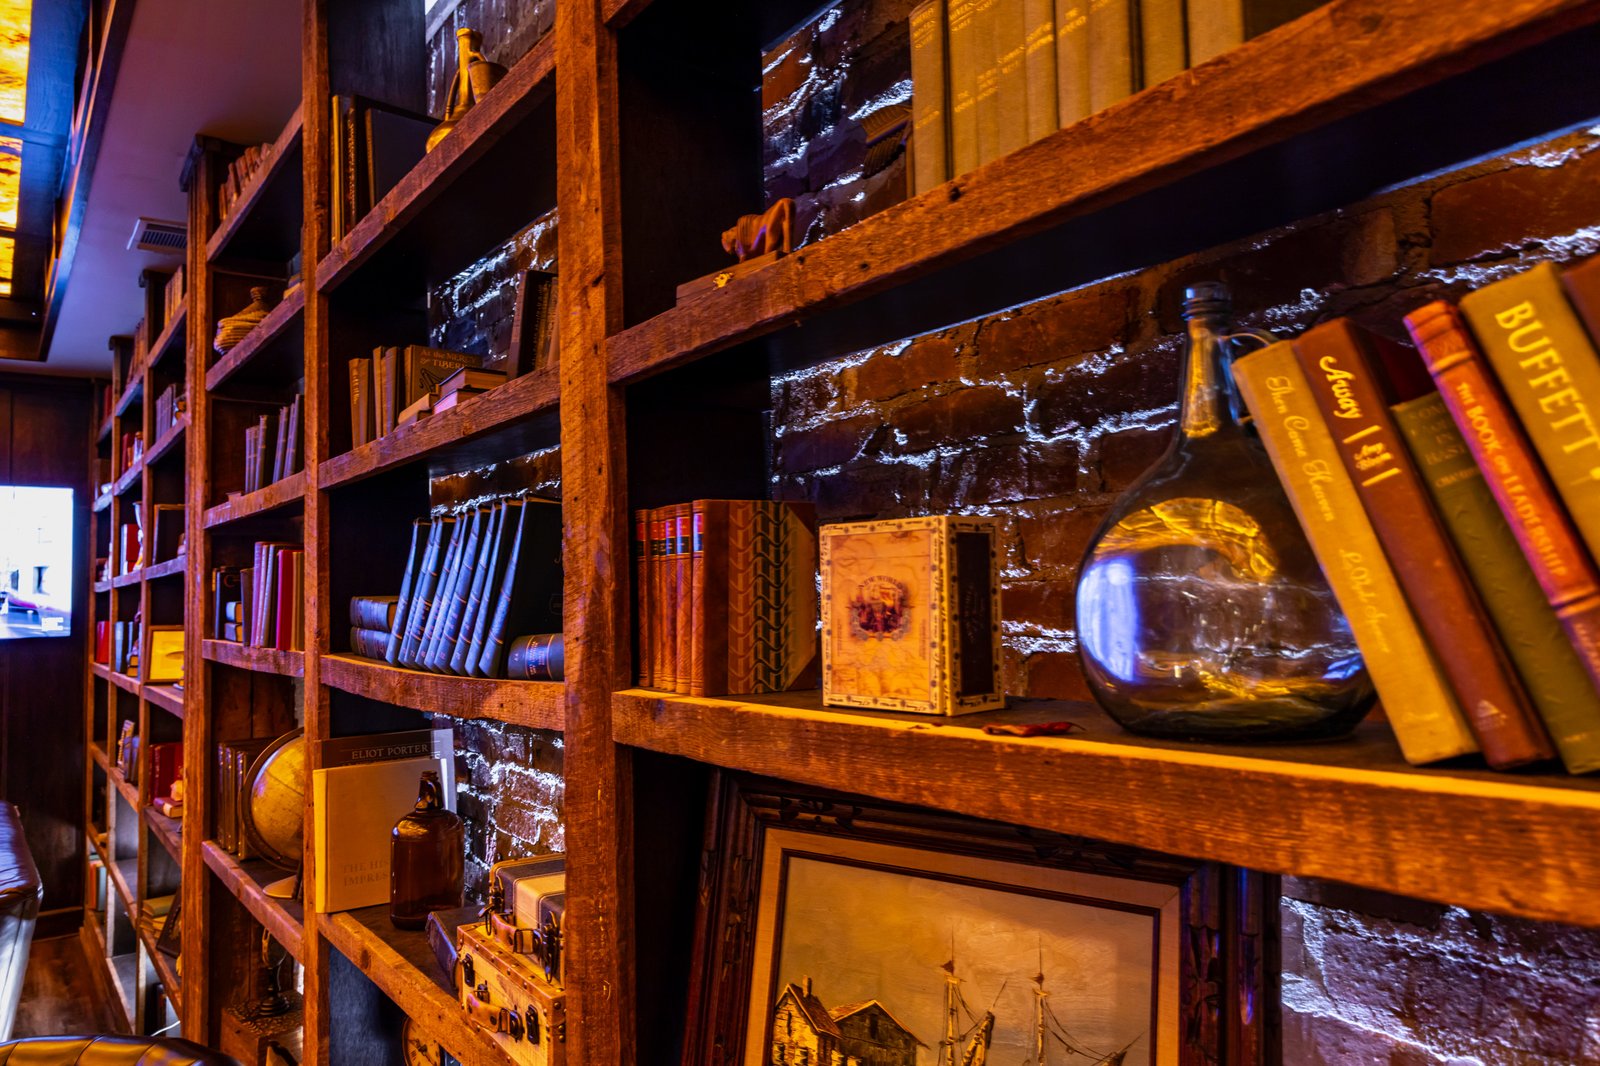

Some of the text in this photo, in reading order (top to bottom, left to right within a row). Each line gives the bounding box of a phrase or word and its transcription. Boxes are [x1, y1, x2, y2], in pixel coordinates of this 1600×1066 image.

[1265, 375, 1336, 522] Then Came Heaven
[1320, 354, 1363, 419] Away
[1496, 300, 1600, 455] BUFFETT
[1456, 382, 1474, 406] THE
[1466, 398, 1500, 454] BOOK
[1502, 474, 1568, 577] LEADERSHIP
[351, 744, 428, 760] ELIOT PORTER
